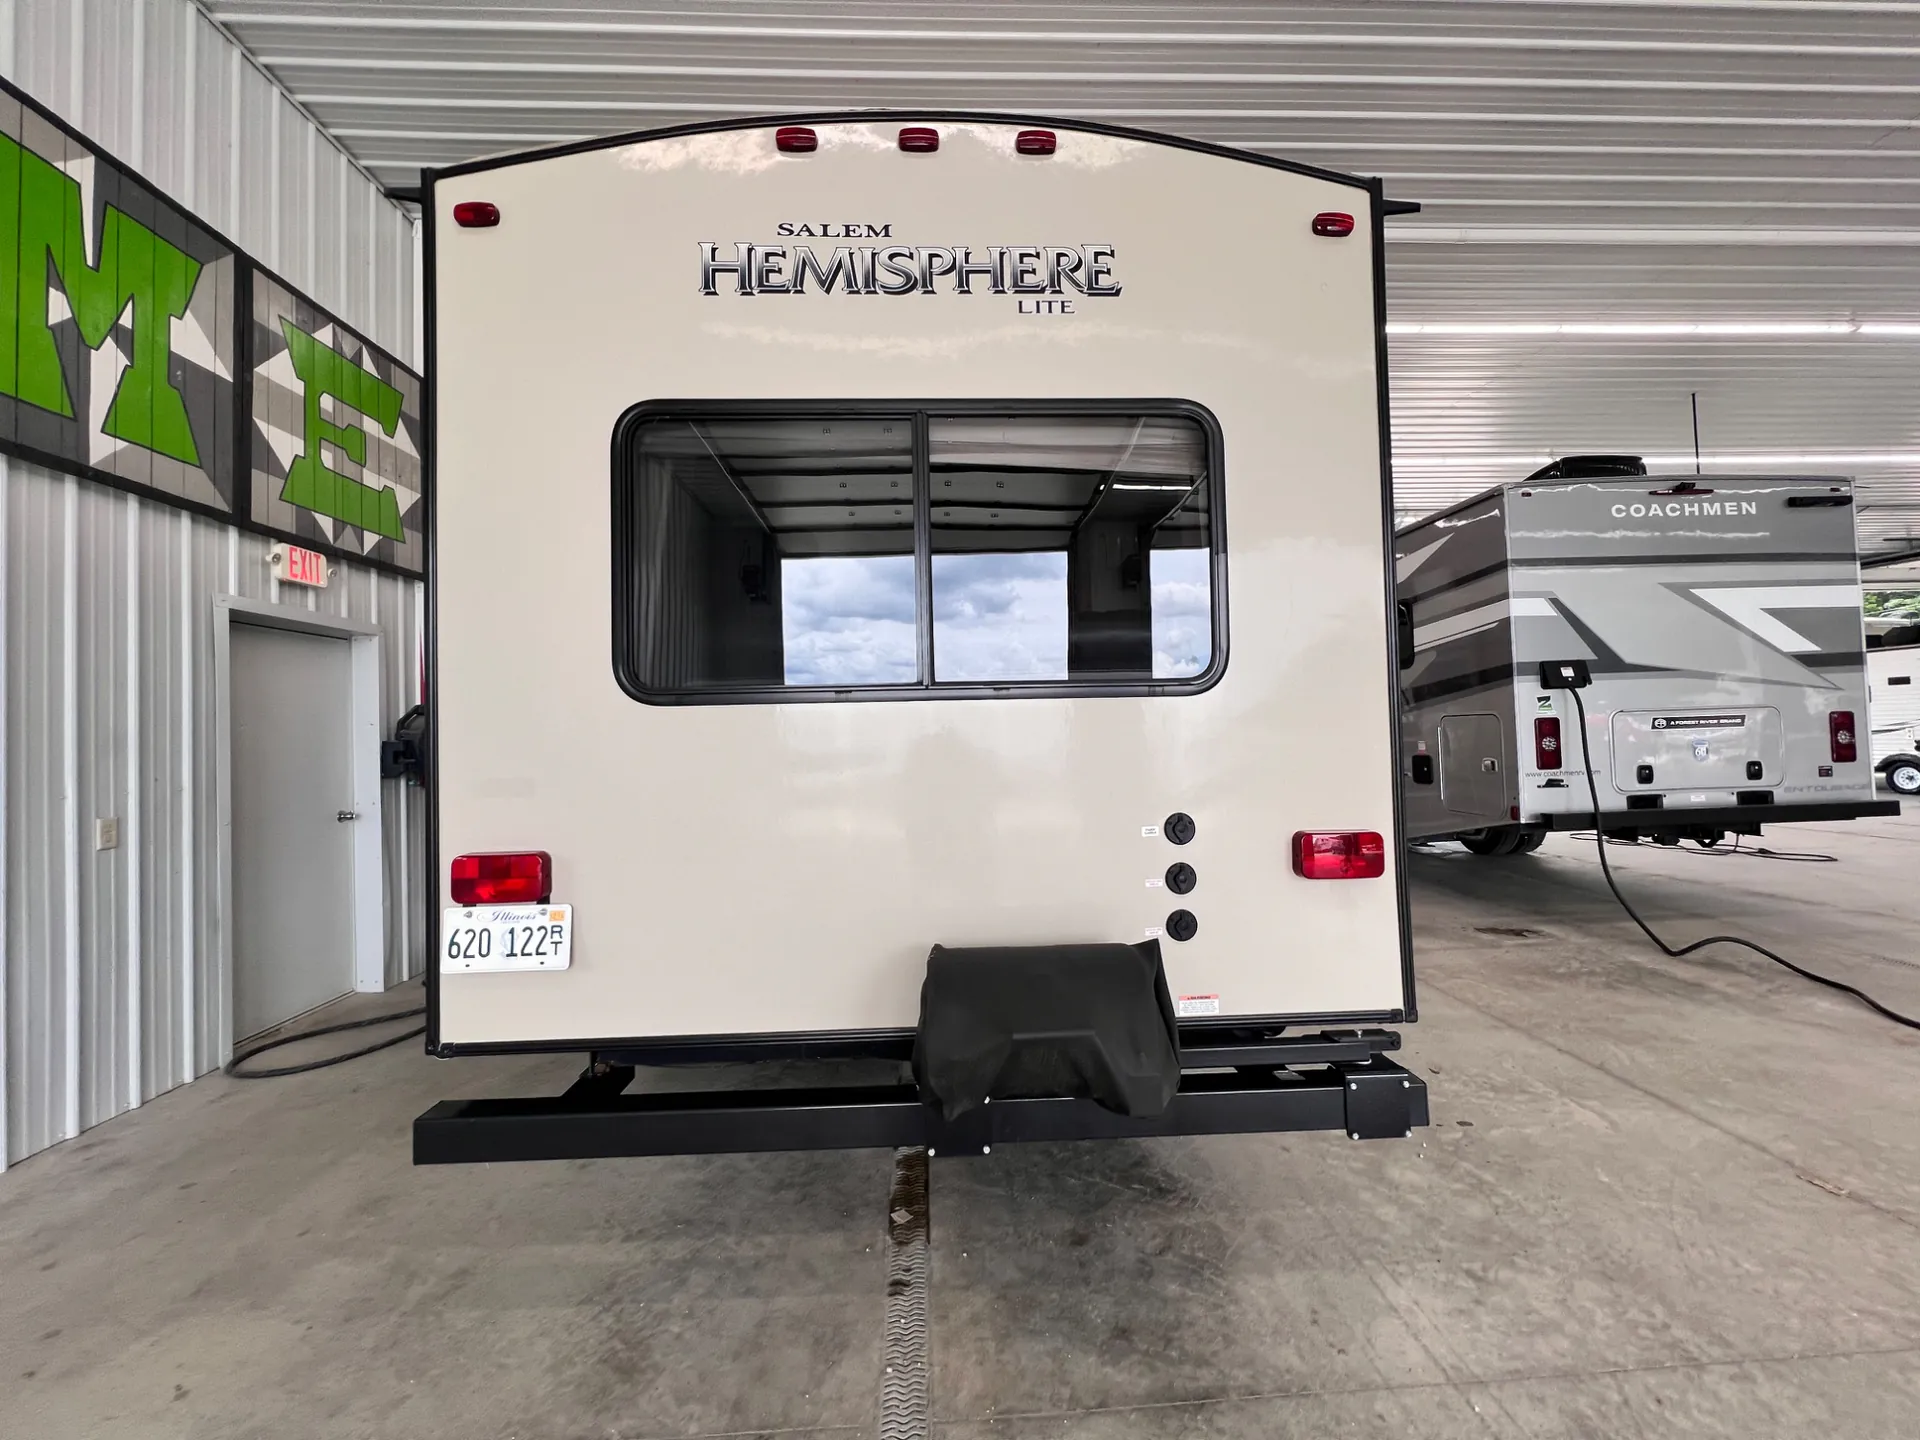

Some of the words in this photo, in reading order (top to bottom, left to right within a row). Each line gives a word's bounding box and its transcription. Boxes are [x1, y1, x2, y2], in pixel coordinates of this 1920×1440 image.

[777, 222, 892, 238] SALEM
[698, 241, 1122, 297] HEMISPHERE
[1018, 299, 1076, 315] LITE
[1611, 501, 1757, 518] COACHMEN
[289, 546, 322, 584] EXIT
[491, 910, 537, 922] Illinois
[448, 928, 491, 959] 620
[505, 925, 548, 957] 122
